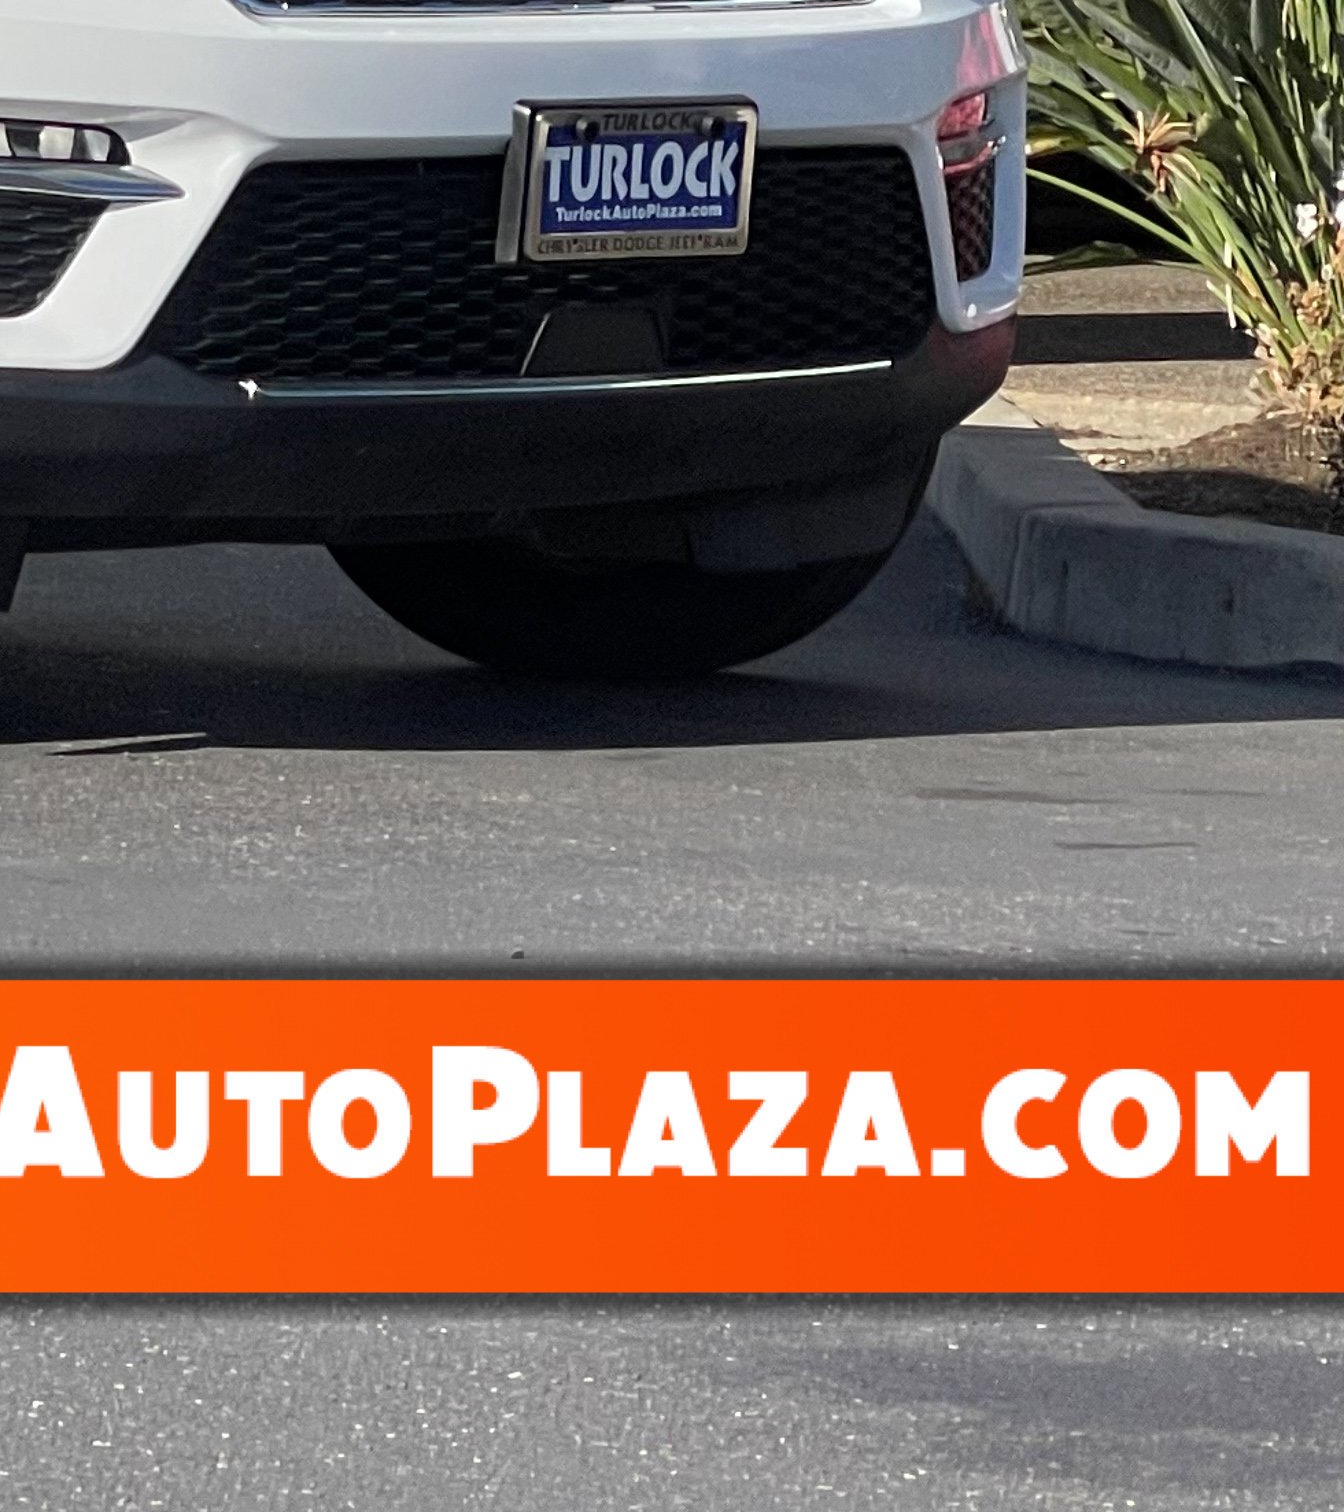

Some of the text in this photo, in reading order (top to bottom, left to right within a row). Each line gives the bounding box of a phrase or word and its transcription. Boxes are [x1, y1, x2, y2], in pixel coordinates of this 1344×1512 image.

[602, 112, 692, 132] TURLOCK
[545, 141, 740, 202] TURLOCK
[556, 204, 723, 222] TurlockAutoPlaza.com
